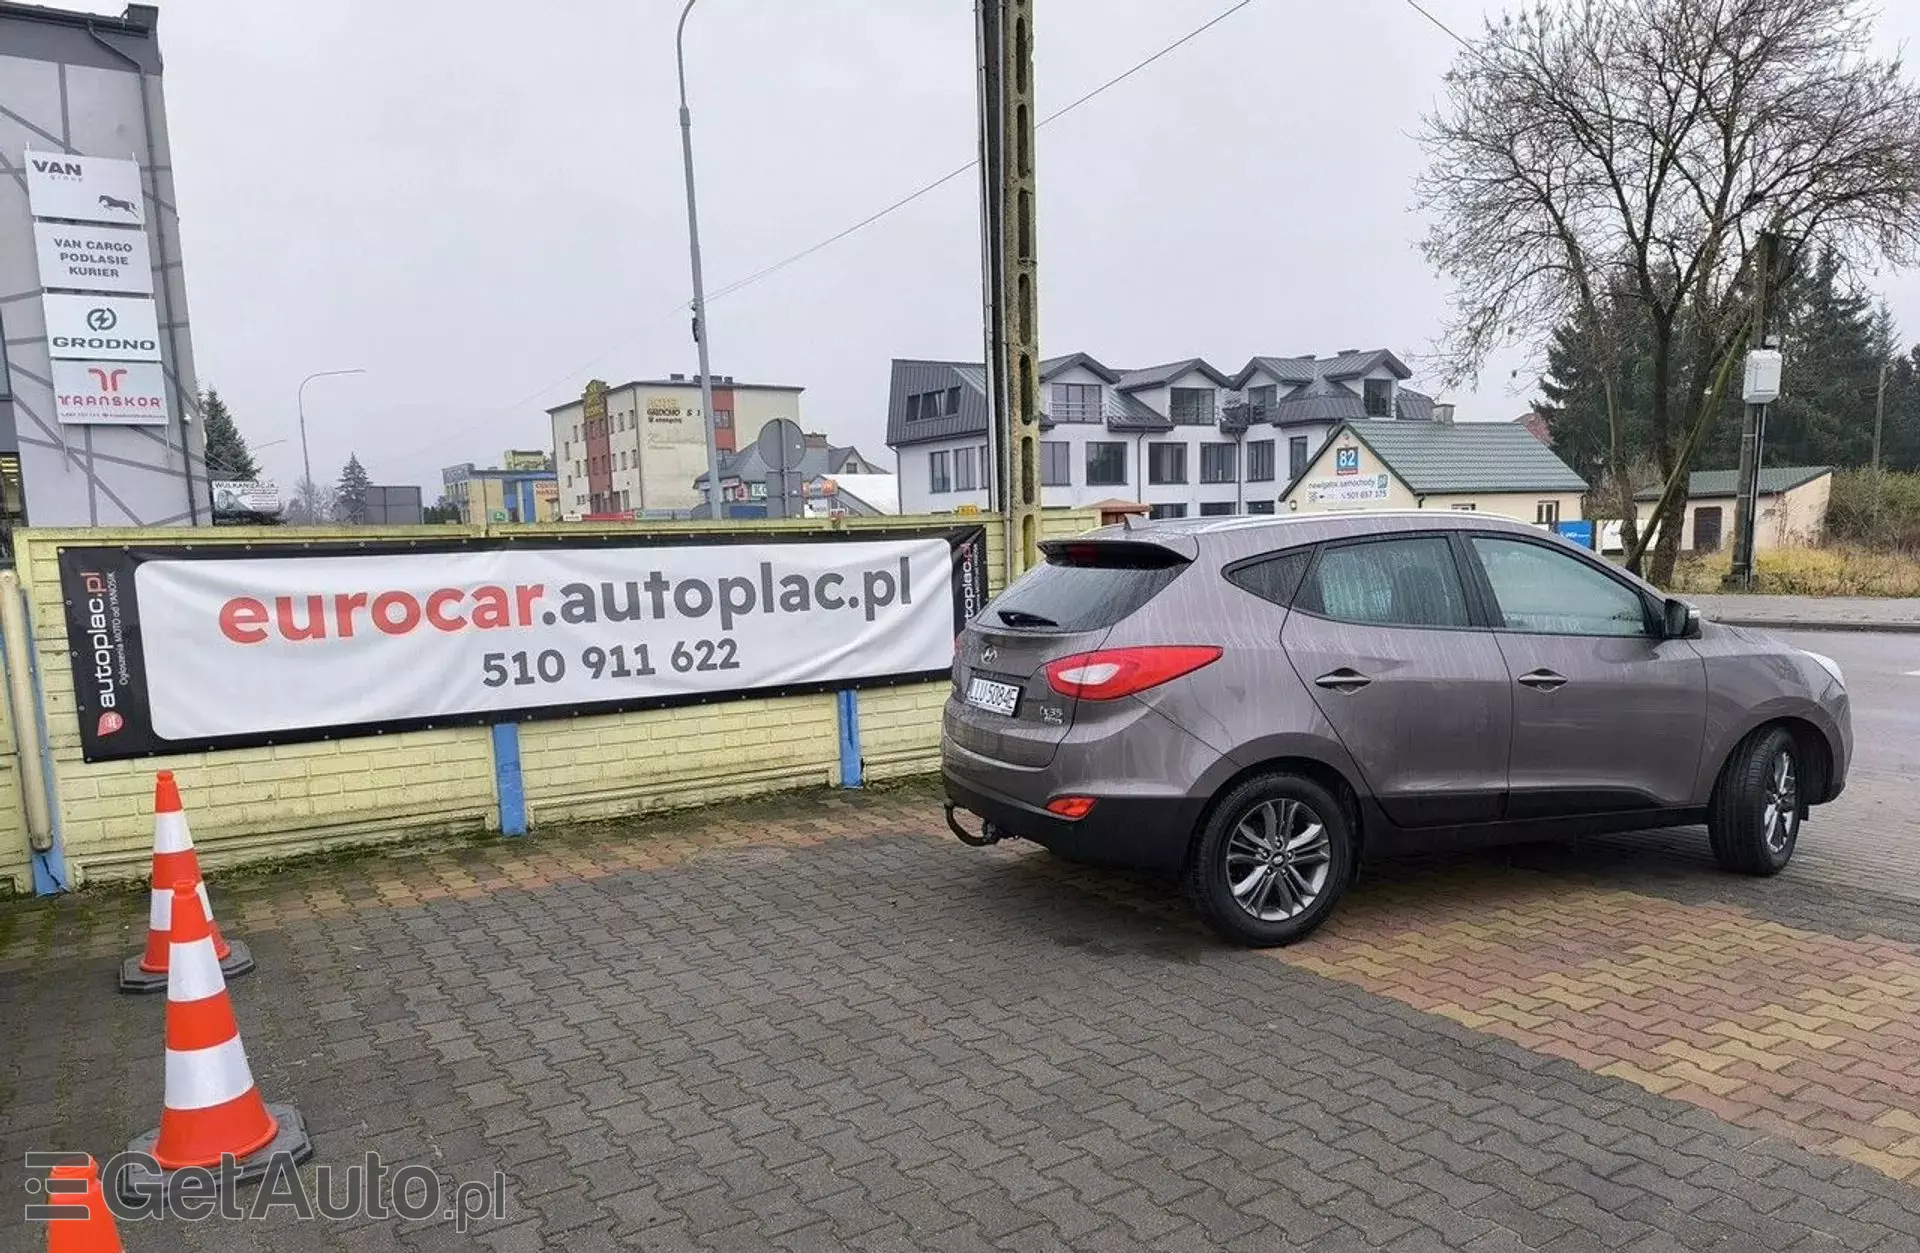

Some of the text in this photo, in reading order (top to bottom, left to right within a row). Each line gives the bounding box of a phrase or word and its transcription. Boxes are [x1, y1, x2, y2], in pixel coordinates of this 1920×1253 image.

[32, 159, 82, 176] VAN
[54, 238, 133, 252] VAN CARGO
[60, 253, 129, 266] PODLASIE
[69, 266, 120, 278] KURIER
[52, 337, 156, 351] GRODNO
[58, 395, 161, 408] TRANSKOR
[1340, 449, 1356, 467] 82
[961, 542, 975, 619] toplac.pl
[217, 556, 913, 646] eurocar.autoplac.pl
[80, 571, 116, 708] autoplac.pl
[112, 619, 122, 643] MOTO
[482, 638, 741, 688] 510 911 622
